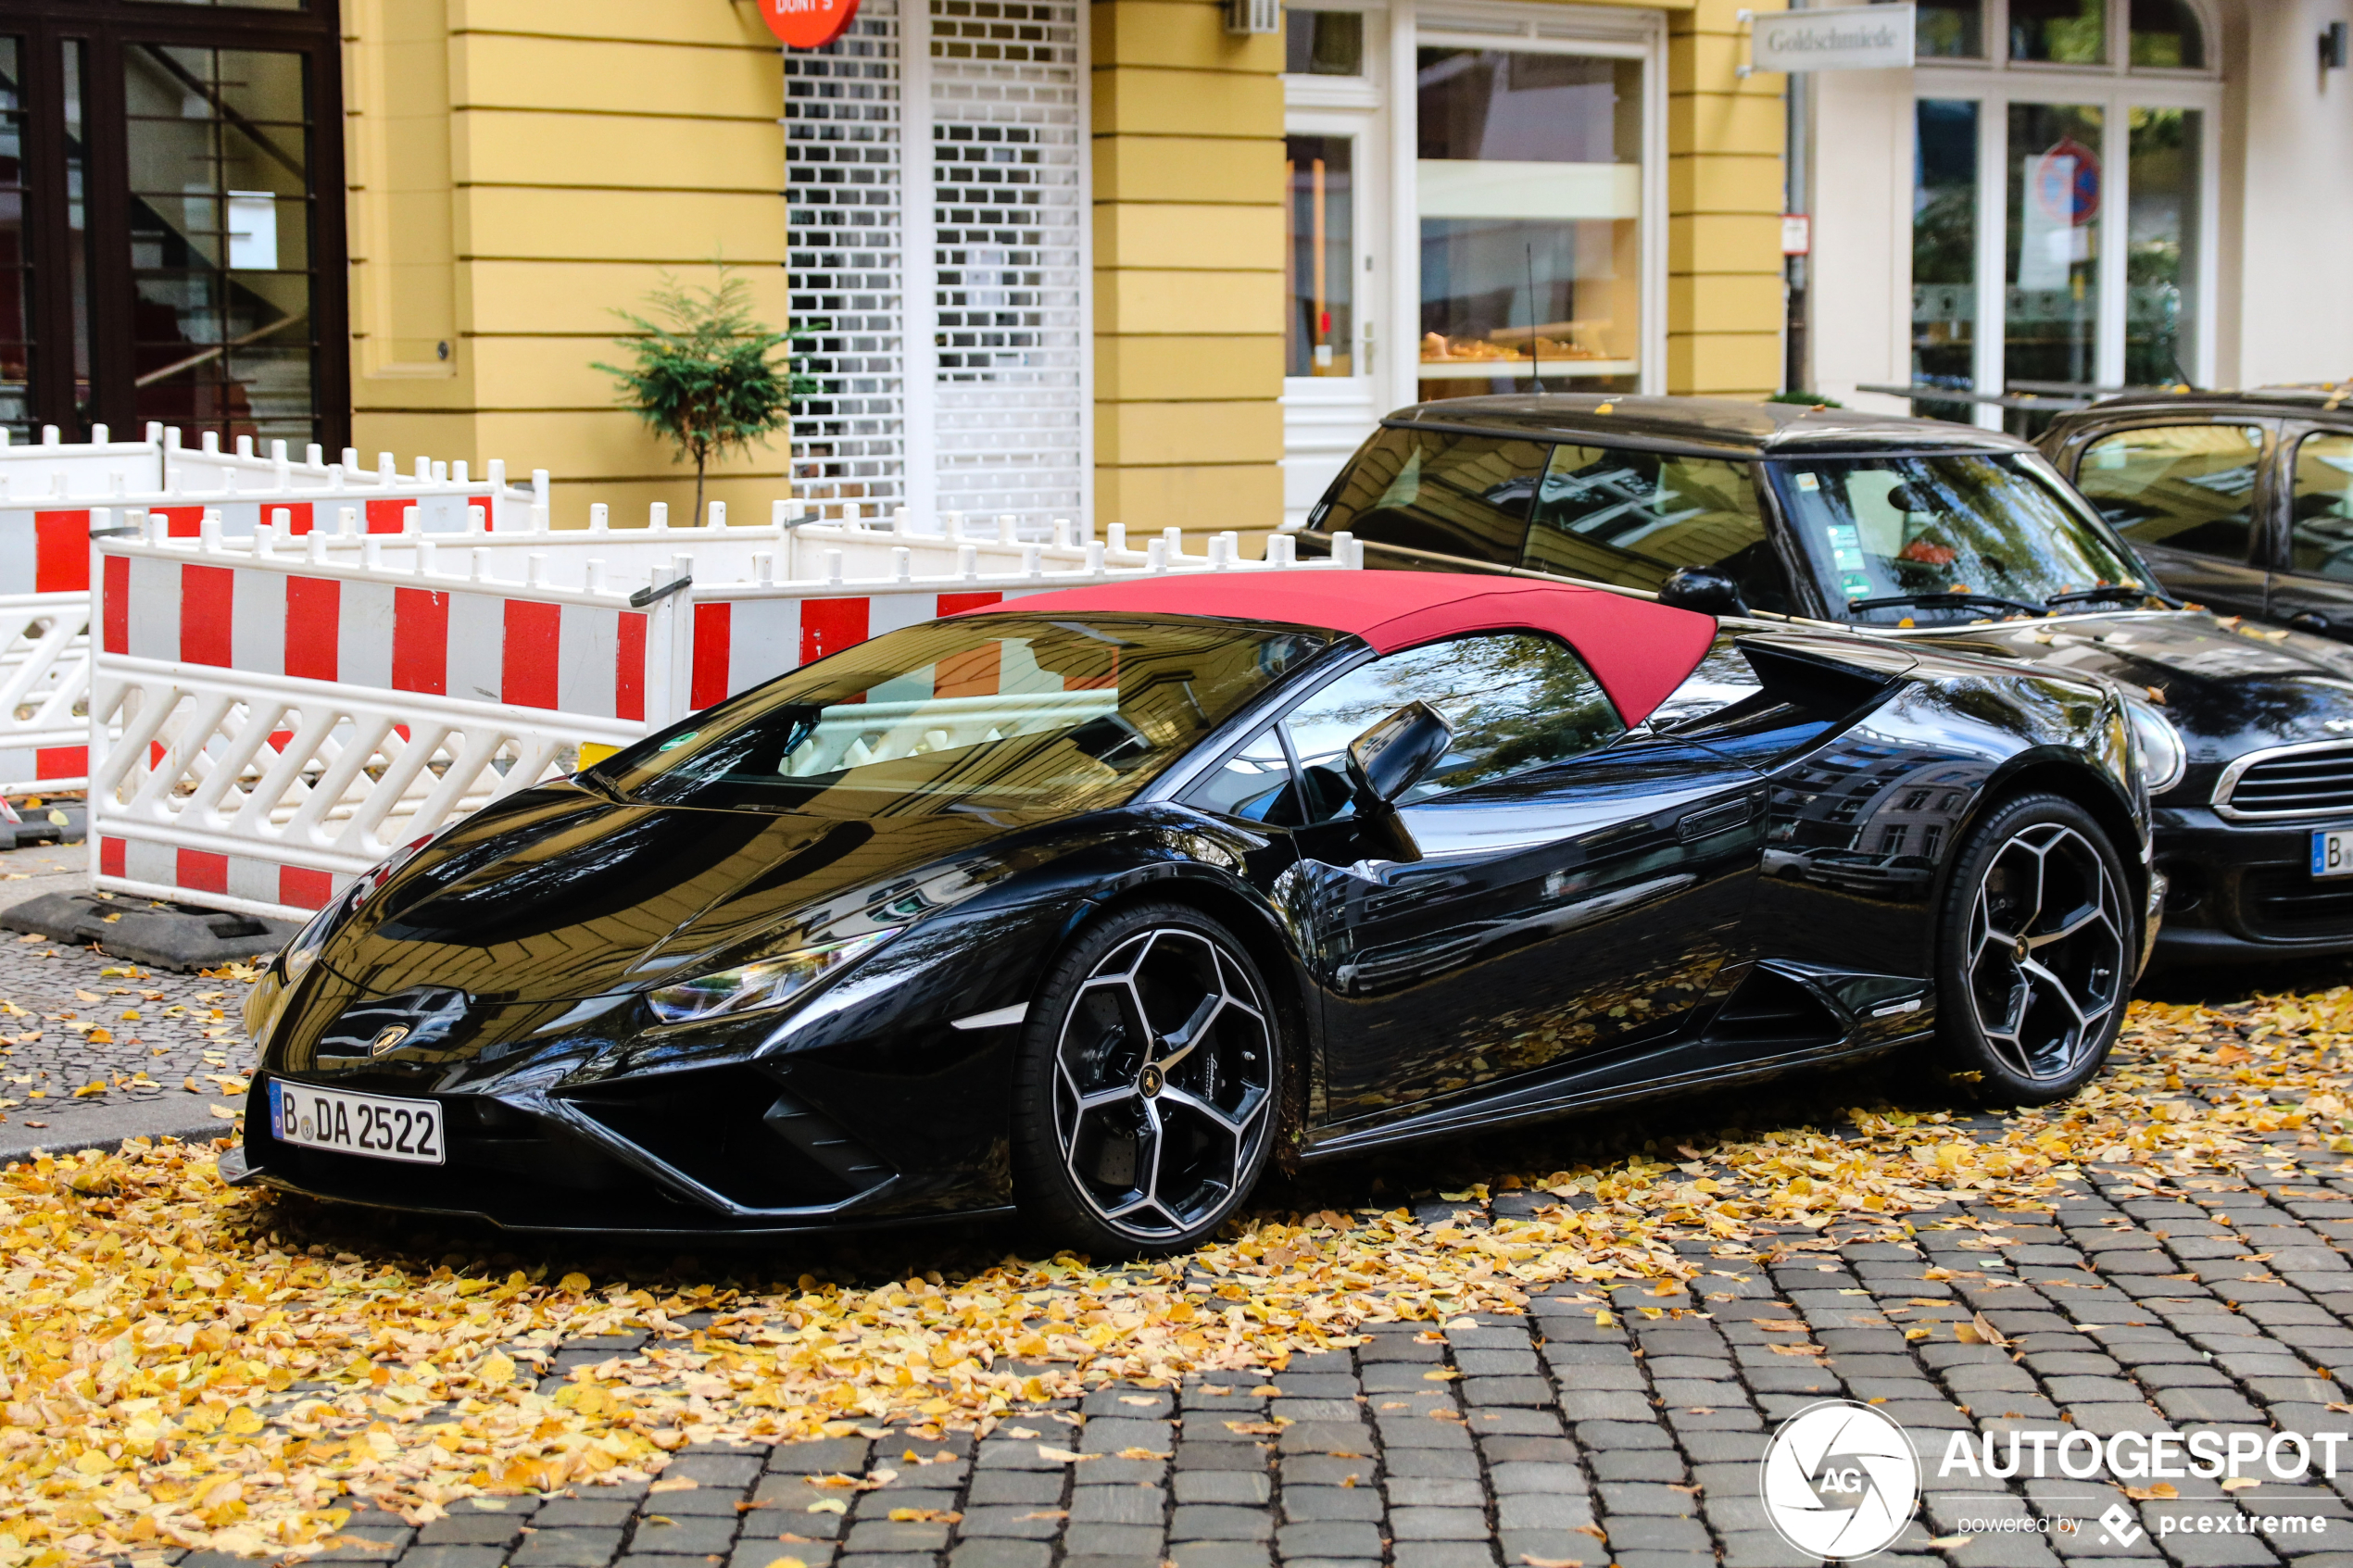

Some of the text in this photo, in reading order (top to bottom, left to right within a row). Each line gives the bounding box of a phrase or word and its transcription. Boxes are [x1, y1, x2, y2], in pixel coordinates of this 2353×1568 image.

[775, 0, 834, 13] DONTS
[1767, 24, 1898, 52] Goldschmiede
[2328, 837, 2341, 868] B
[1208, 1052, 1218, 1102] Lamborgh
[275, 1115, 281, 1128] D
[283, 1091, 437, 1156] B DA 2522
